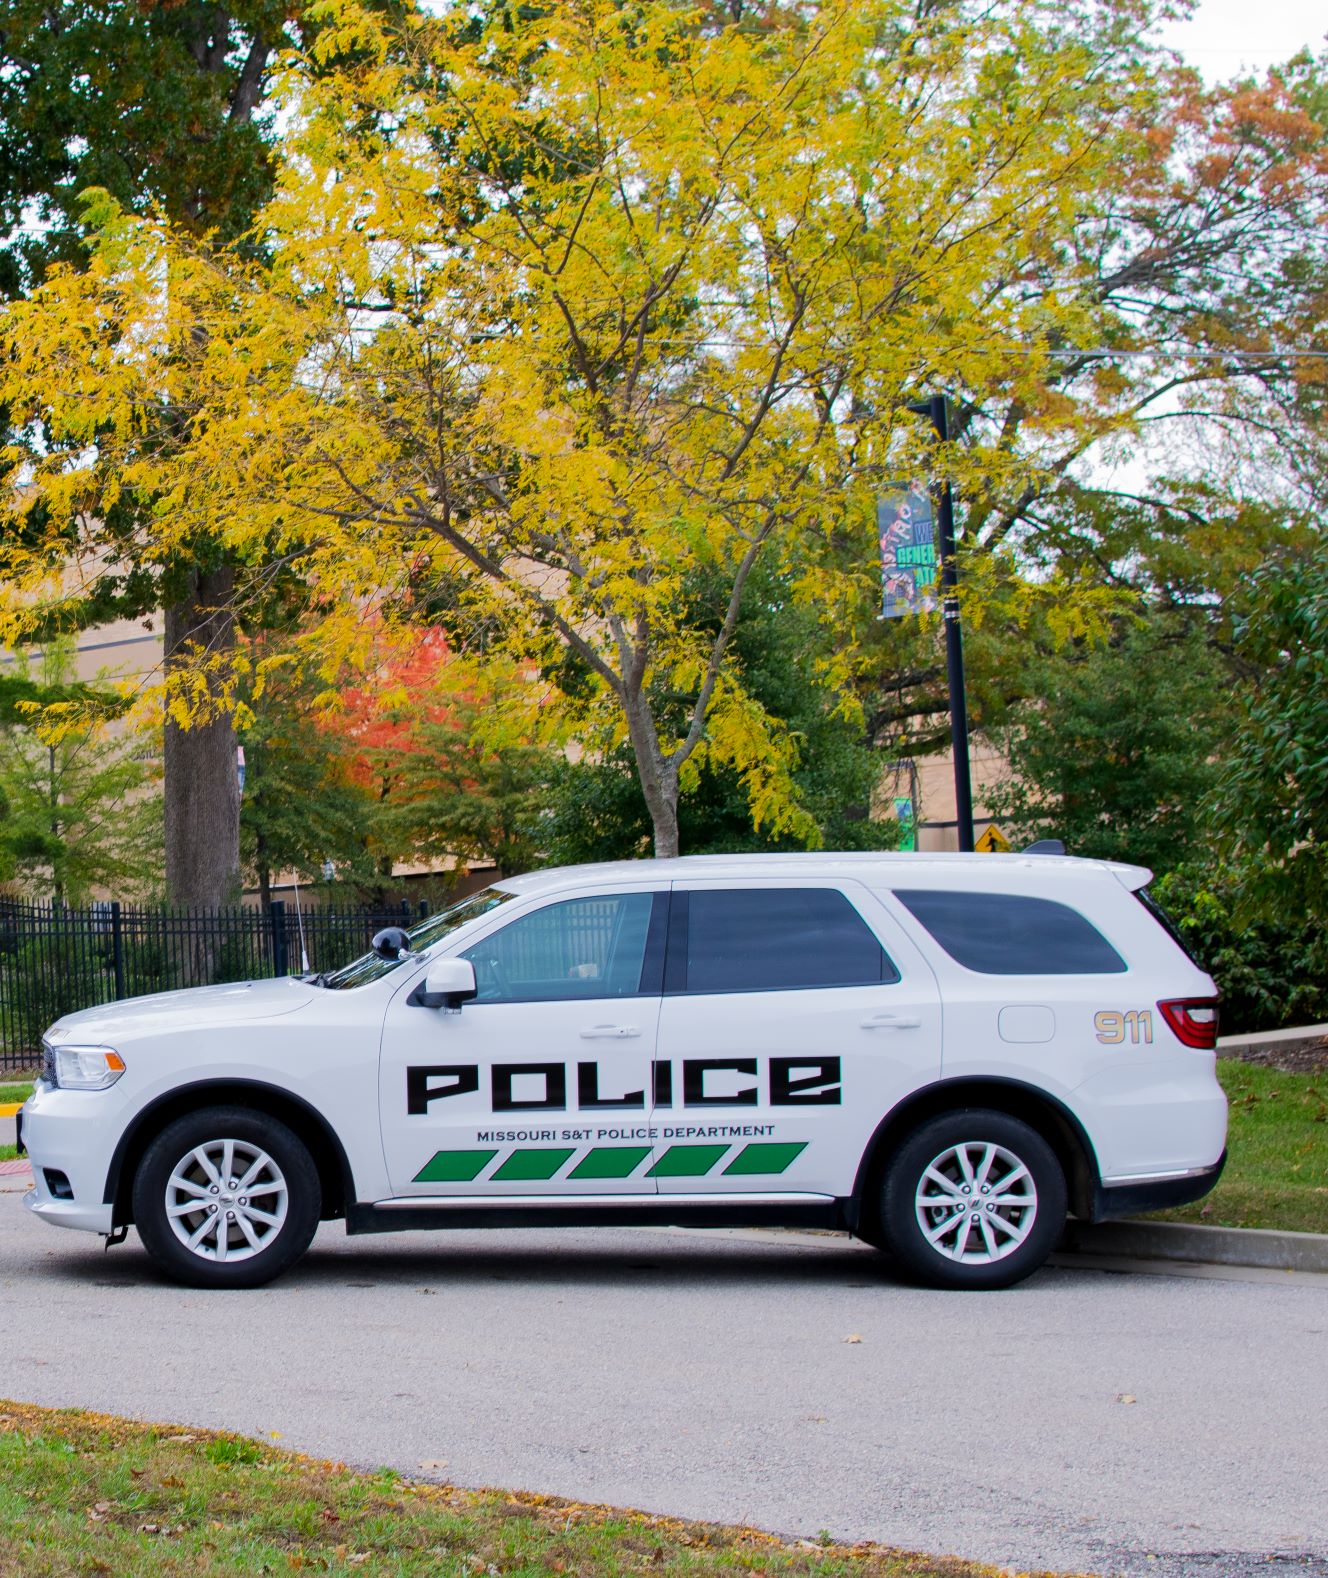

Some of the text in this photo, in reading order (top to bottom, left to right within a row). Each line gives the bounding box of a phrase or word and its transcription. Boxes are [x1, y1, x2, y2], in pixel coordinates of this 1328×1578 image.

[1094, 1010, 1153, 1045] 911
[406, 1056, 841, 1115] POLICE
[477, 1125, 775, 1142] MISSOURI S&T POLICE DEPARTMENT
